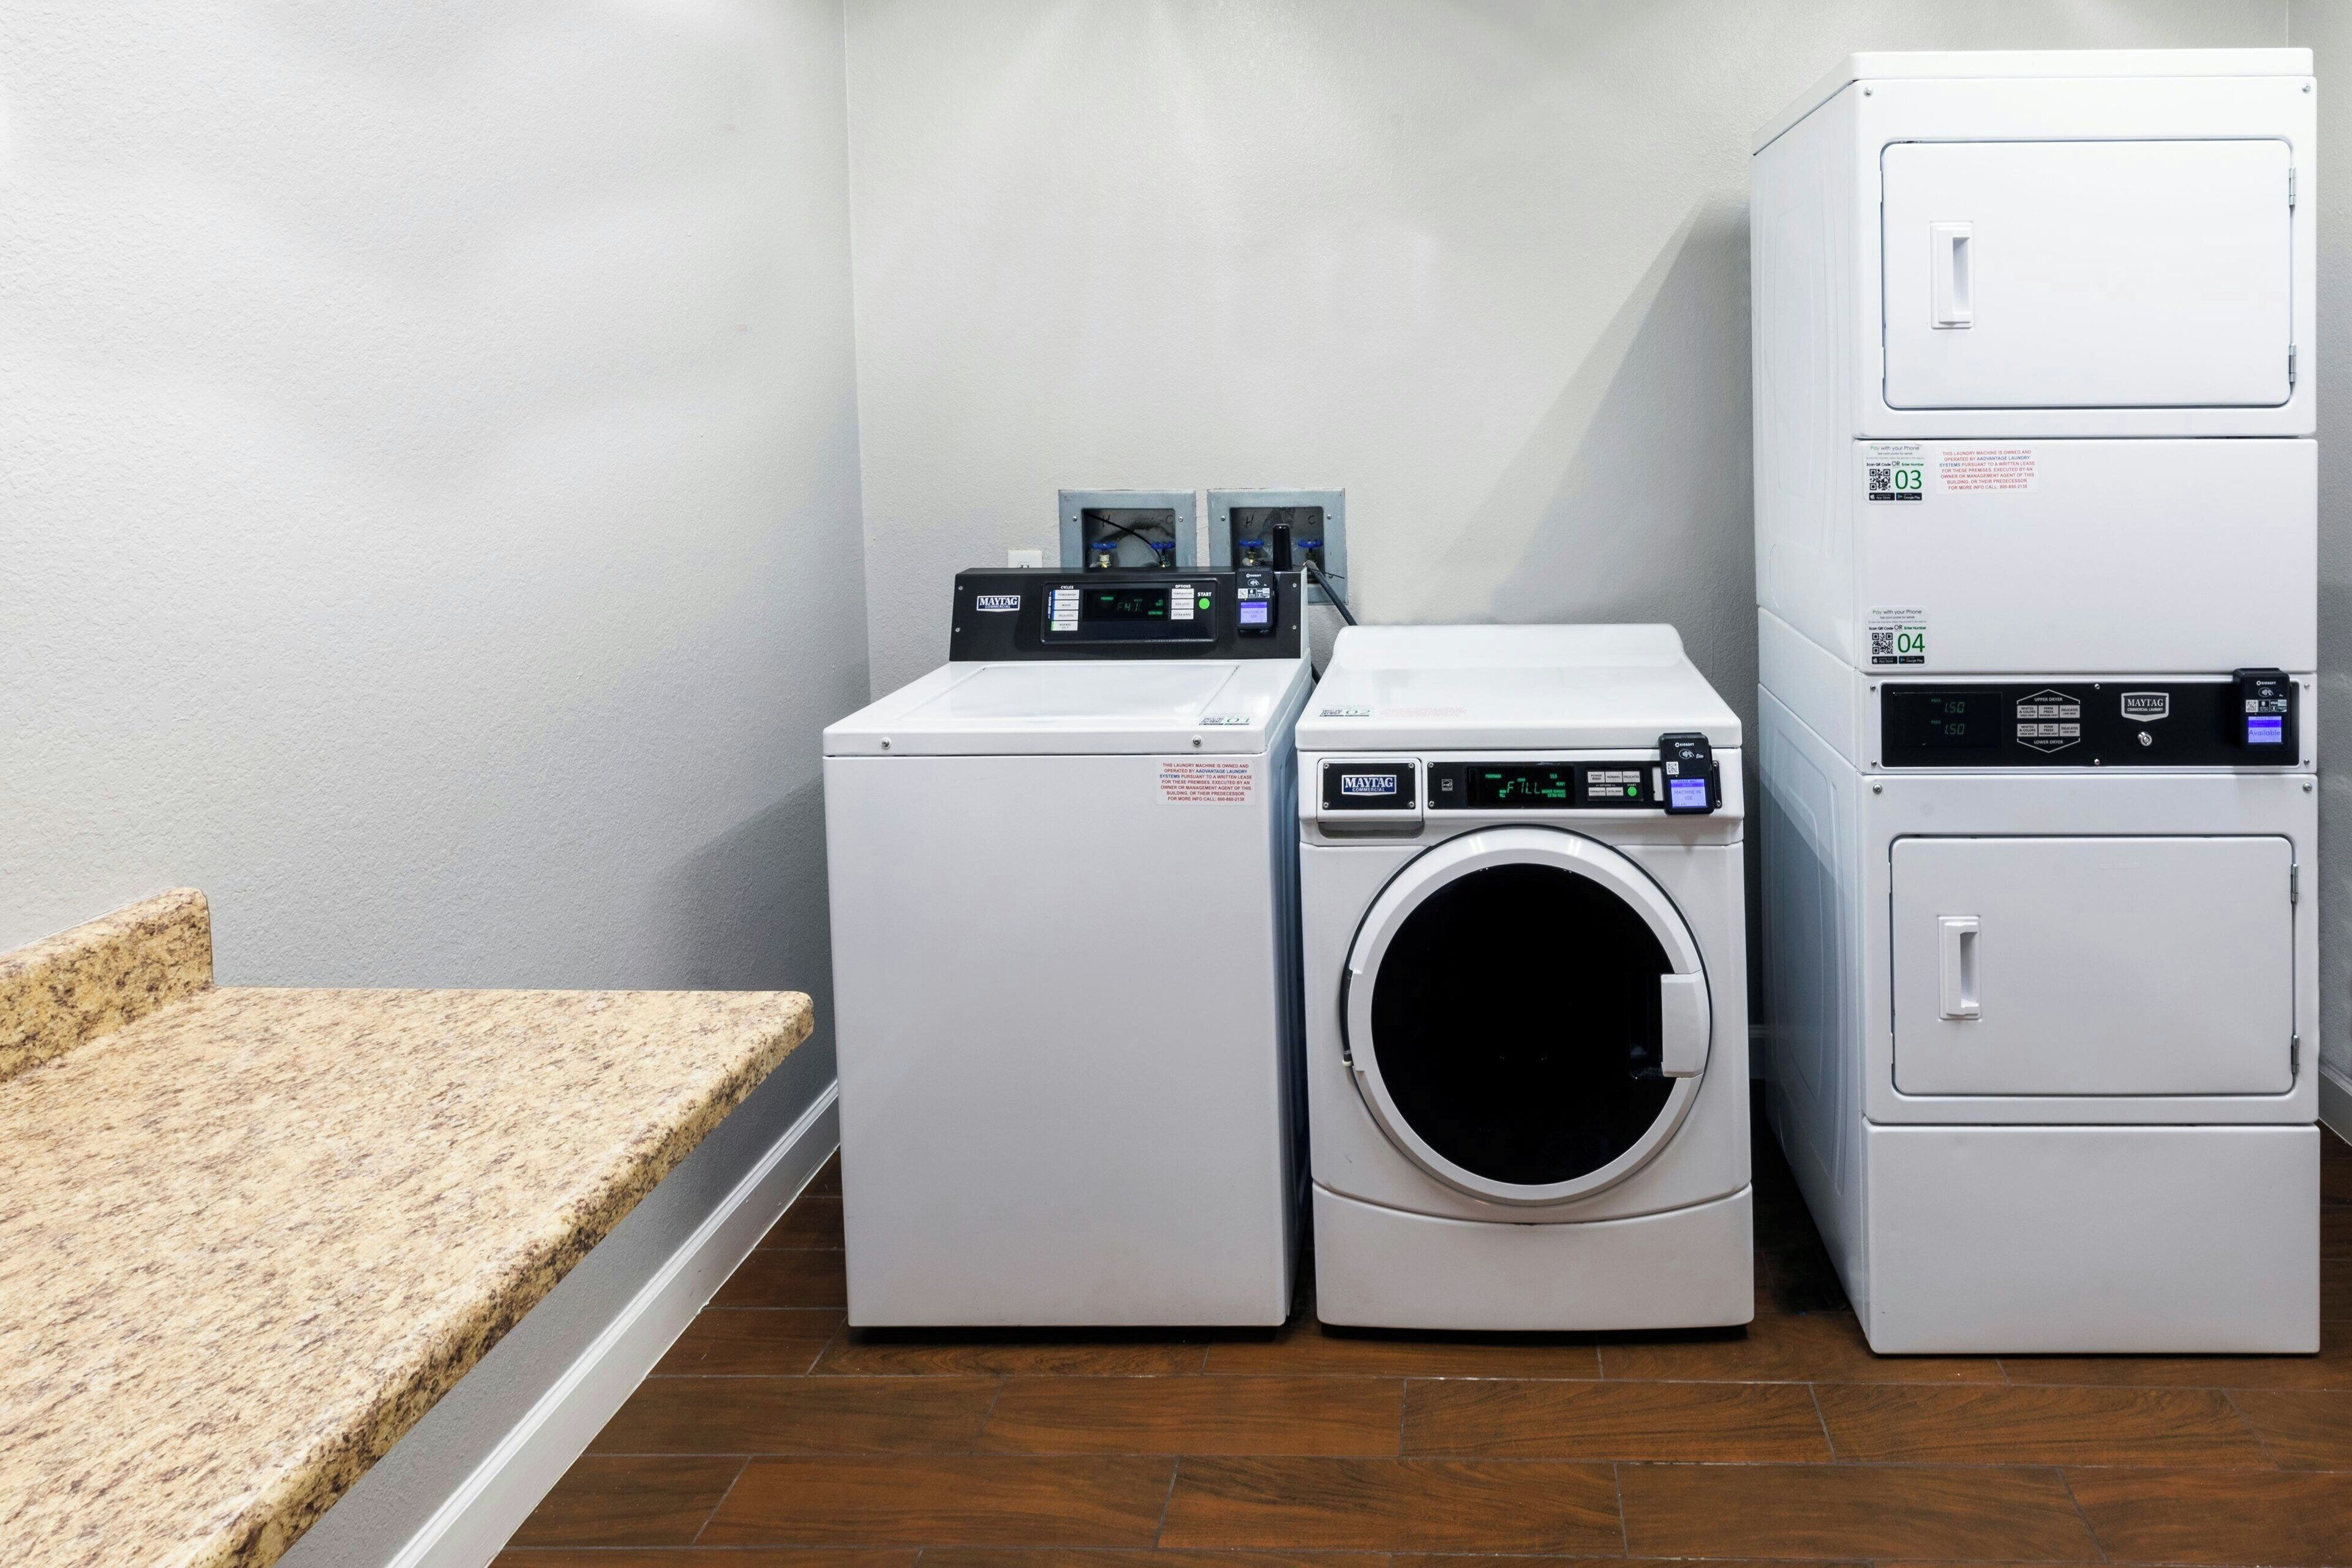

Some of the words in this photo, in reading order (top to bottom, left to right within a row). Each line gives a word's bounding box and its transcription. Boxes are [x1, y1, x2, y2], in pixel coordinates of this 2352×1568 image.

[1895, 470, 1922, 489] 03
[1245, 514, 1254, 529] H
[1308, 515, 1314, 524] C
[1898, 633, 1925, 652] 04
[1945, 724, 1965, 734] 1.50
[1345, 778, 1393, 788] MAYTAG
[1507, 782, 1540, 794] FILL
